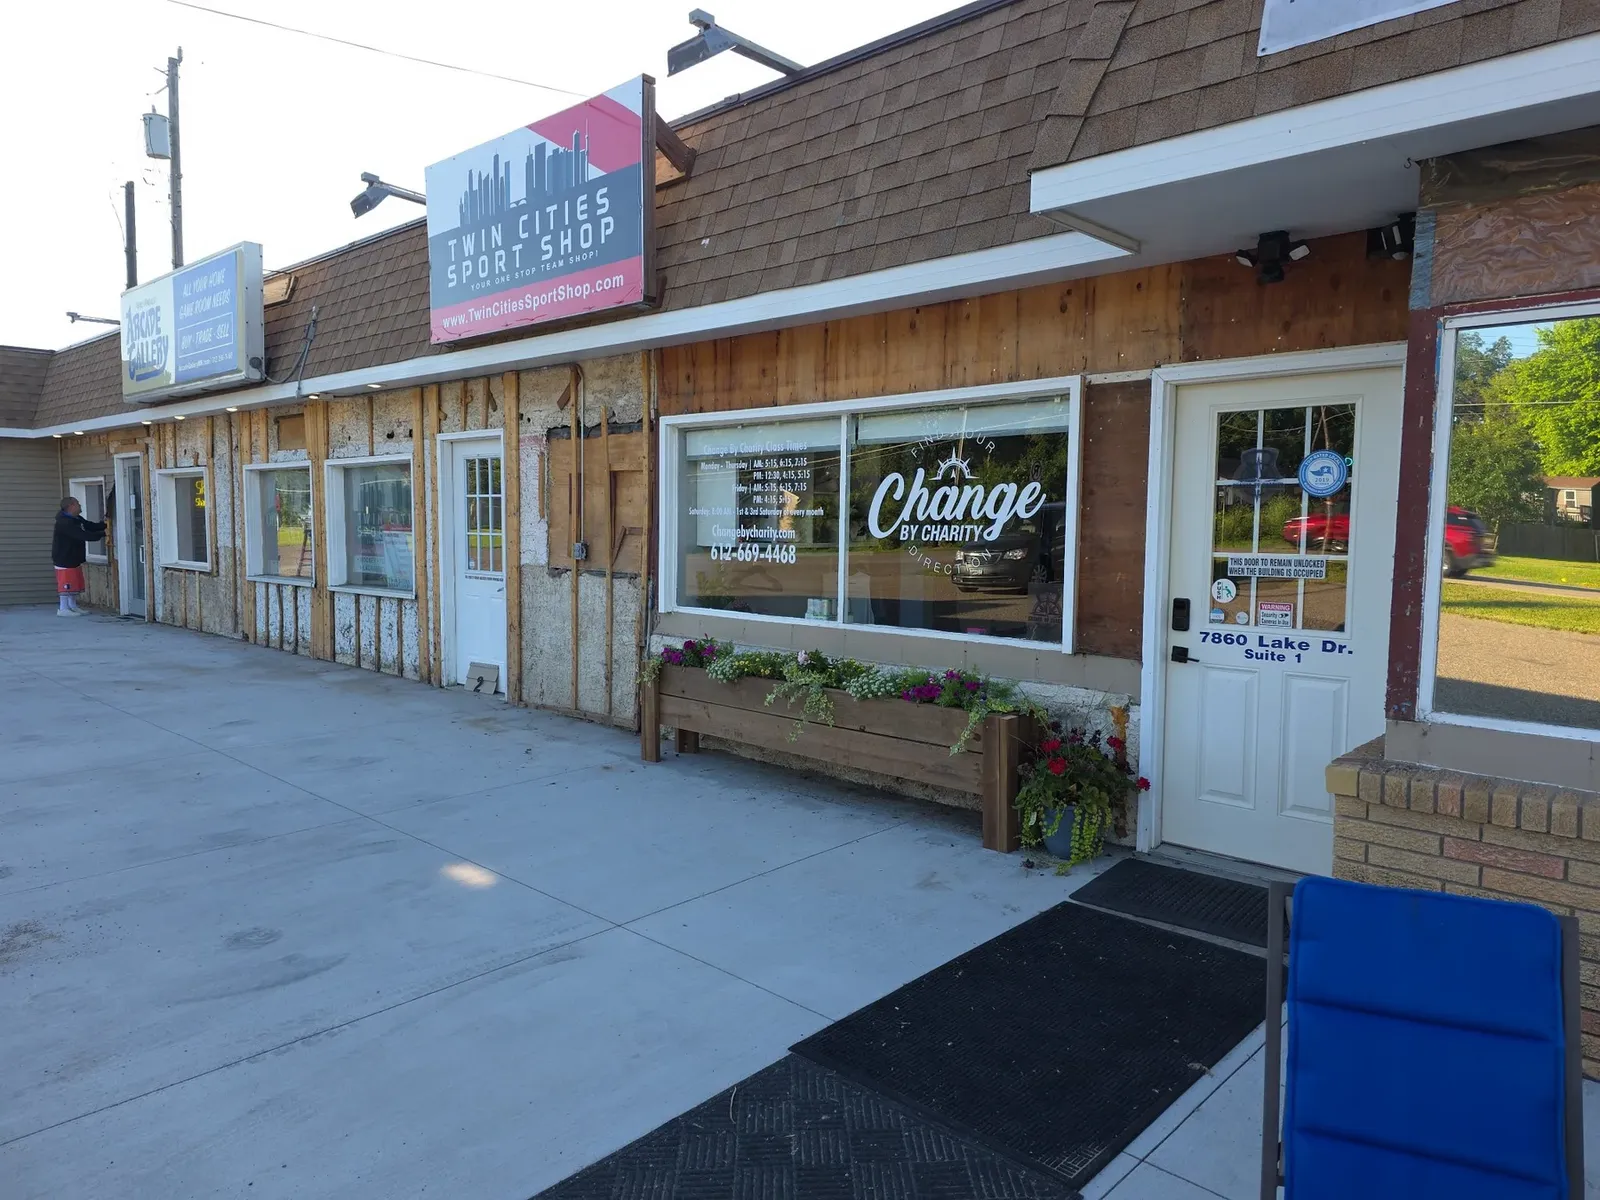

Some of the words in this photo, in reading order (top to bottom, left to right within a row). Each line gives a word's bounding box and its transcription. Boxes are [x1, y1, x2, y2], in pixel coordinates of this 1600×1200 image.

[448, 223, 502, 262] TWIN
[518, 186, 609, 239] CITIES
[447, 243, 523, 288] SPORT
[540, 216, 615, 261] SHOP
[471, 279, 491, 291] YOUR
[494, 273, 511, 285] ONE
[514, 267, 537, 279] STOP
[540, 259, 564, 272] TEAM
[569, 250, 599, 264] SHOP!
[182, 282, 192, 297] ALL
[193, 274, 208, 293] YOUR
[208, 268, 226, 287] HOME
[180, 301, 194, 319] GAME
[194, 294, 212, 314] ROOM
[211, 288, 232, 309] NEEDS
[442, 274, 624, 328] www.TwinCitiesSportShop.com
[126, 305, 162, 346] ARCADE
[181, 334, 193, 350] BUY
[195, 327, 214, 345] TRADE
[216, 321, 230, 340] SELL
[127, 335, 169, 381] GALLERY
[703, 443, 728, 458] Change
[729, 443, 739, 457] By
[739, 442, 764, 455] Charity
[786, 440, 808, 450] Times
[700, 461, 721, 472] Monday
[725, 460, 748, 471] Thursday
[753, 459, 764, 468] AM:
[765, 458, 779, 469] 5:15,
[779, 457, 794, 468] 6:15,
[794, 457, 808, 467] 7:15
[753, 471, 764, 480] PM:
[765, 470, 782, 481] 12:30,
[782, 470, 797, 480] 4:15,
[797, 469, 811, 479] 5:15
[731, 484, 748, 494] Friday
[764, 484, 779, 493] 5:15,
[779, 483, 794, 493] 6:15,
[794, 483, 808, 491] 7:15
[753, 495, 764, 504] PM:
[764, 495, 778, 505] 4:15,
[868, 467, 1047, 541] Change
[744, 507, 749, 516] &
[749, 506, 759, 516] 3rd
[759, 507, 782, 518] Saturday
[783, 506, 789, 516] of
[789, 509, 805, 518] every
[712, 524, 796, 541] Changebycharity.com
[899, 524, 921, 541] BY
[921, 524, 984, 541] CHARITY
[710, 543, 797, 564] 612-669-4468
[908, 546, 993, 576] DIRECTION
[1229, 557, 1243, 567] THIS
[1243, 557, 1260, 567] DOOR
[1260, 558, 1269, 567] TO
[1269, 558, 1293, 567] REMAIN
[1293, 559, 1325, 568] UNLOCKED
[1228, 567, 1245, 575] WHEN
[1246, 567, 1257, 576] THE
[1257, 567, 1285, 577] BUILDING
[1285, 568, 1293, 577] IS
[1293, 569, 1324, 578] OCCUPIED
[1261, 611, 1278, 619] Security
[1199, 631, 1248, 646] 7860
[1258, 635, 1310, 651] Lake
[1321, 640, 1353, 655] Dr.
[1244, 648, 1286, 663] Suite
[1294, 653, 1303, 664] 1
[473, 676, 484, 693] 2
